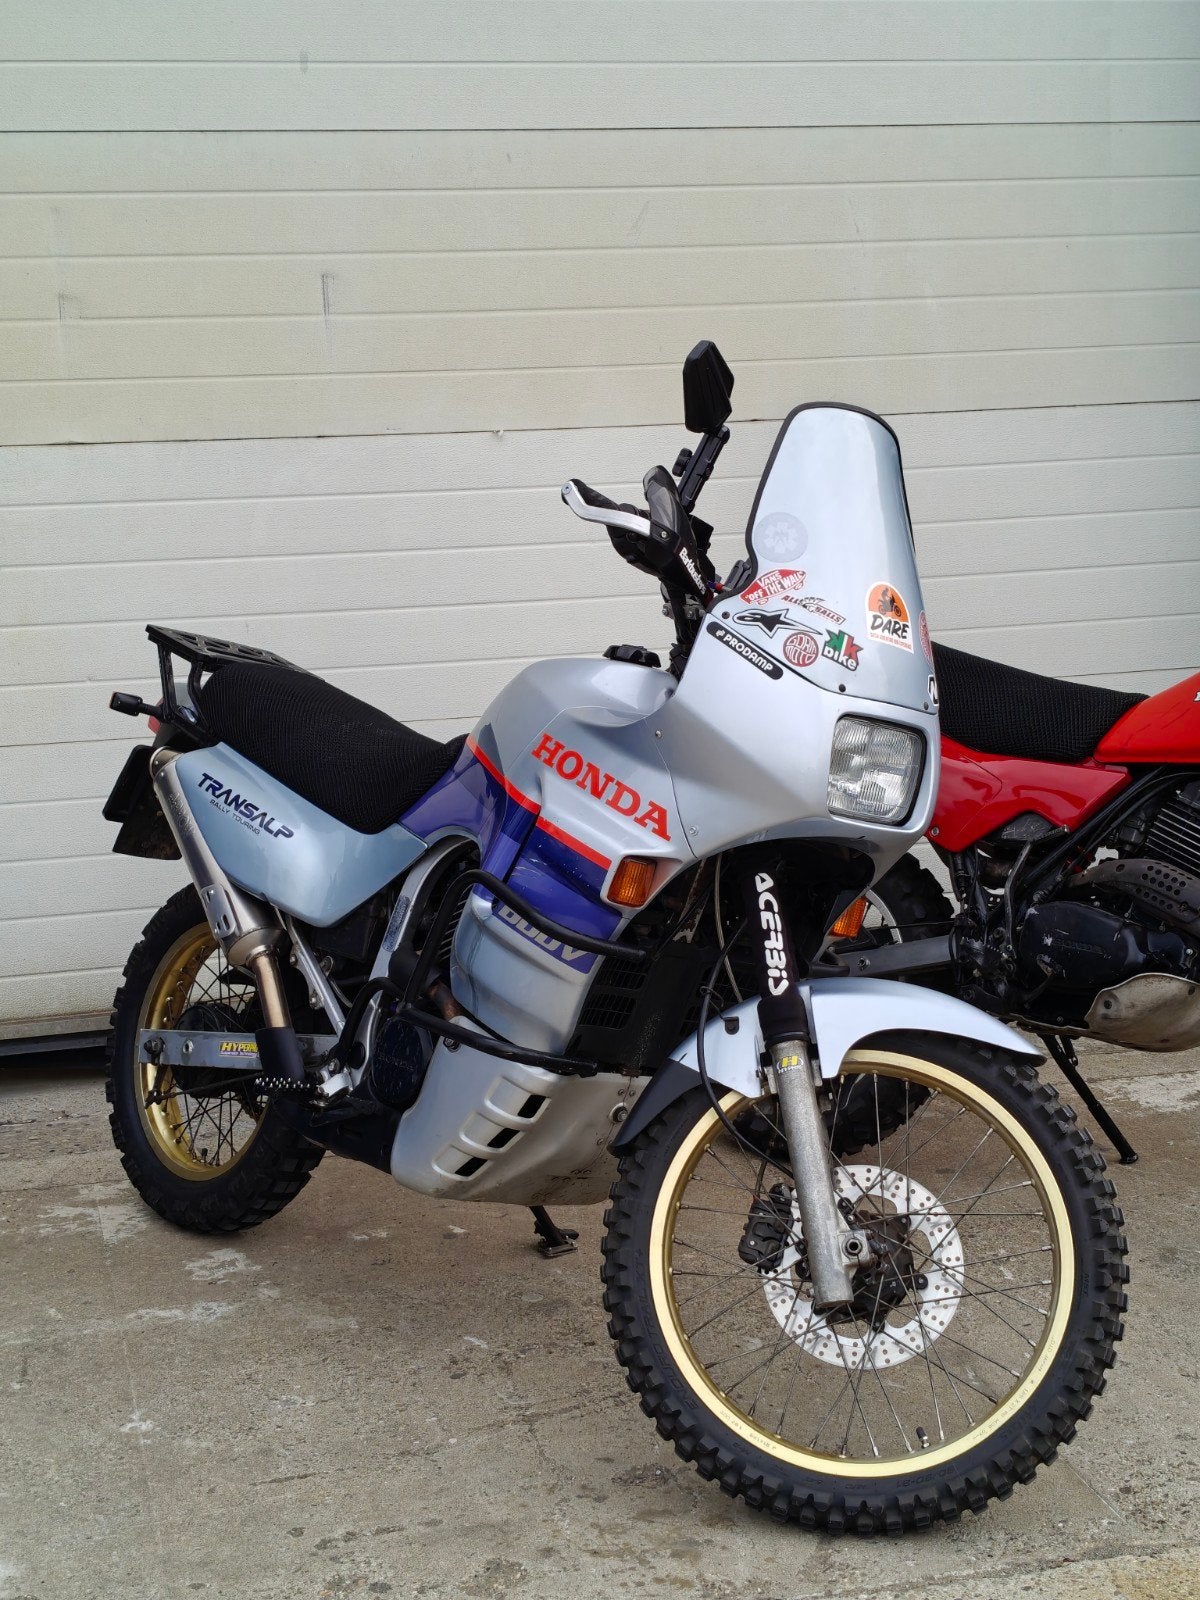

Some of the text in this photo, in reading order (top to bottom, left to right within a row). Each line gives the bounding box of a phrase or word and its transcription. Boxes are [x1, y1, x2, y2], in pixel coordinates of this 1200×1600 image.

[757, 571, 782, 587] VANS
[765, 581, 783, 596] THE
[815, 606, 842, 623] BALLS
[870, 614, 910, 640] DARE
[724, 630, 774, 673] PRODAMP
[531, 733, 672, 842] HONDA
[198, 772, 294, 838] TRANSALP
[210, 799, 231, 814] RALLY
[232, 813, 261, 835] TOURING
